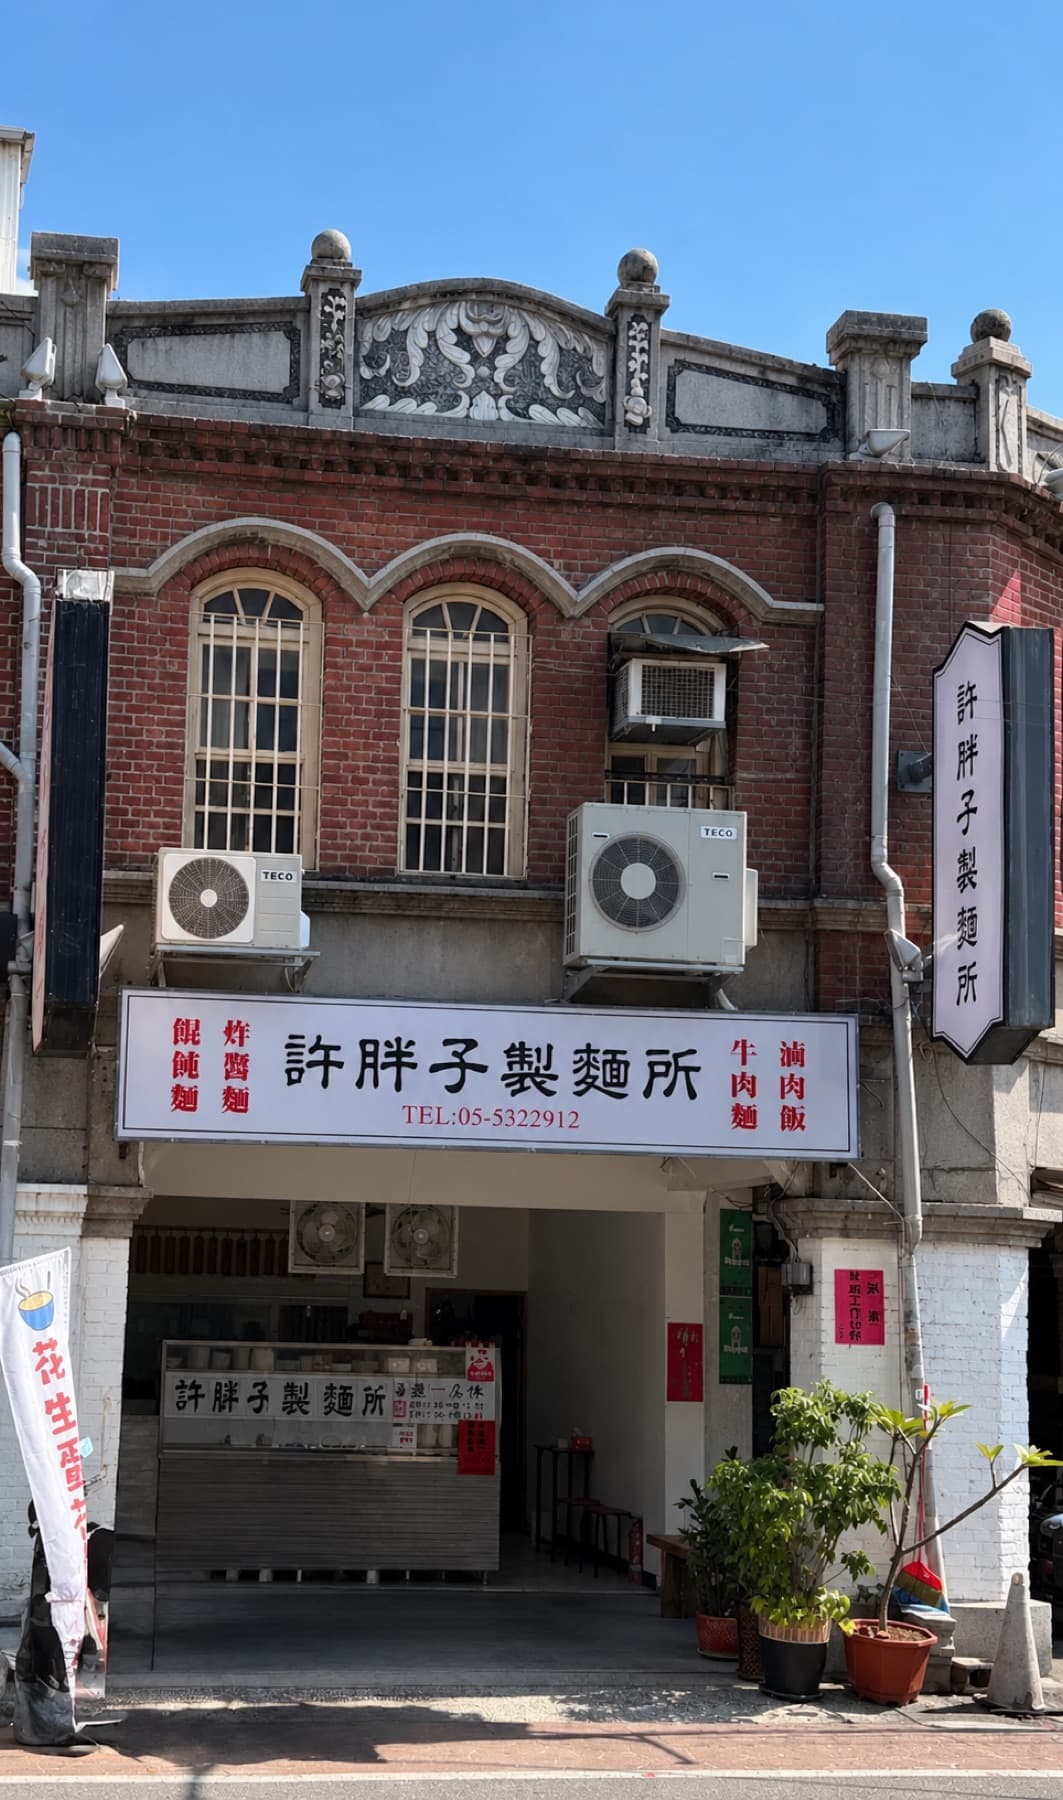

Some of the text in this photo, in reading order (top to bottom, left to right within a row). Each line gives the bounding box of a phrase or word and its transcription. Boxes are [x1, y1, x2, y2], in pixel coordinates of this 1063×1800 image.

[703, 827, 733, 838] TECO
[956, 681, 979, 1006] 許胖子製麵所
[261, 871, 294, 881] TECO
[170, 1017, 201, 1113] 餛飩麵
[222, 1019, 250, 1114] 炸醬麵
[284, 1033, 703, 1101] 許胖子製麵所
[730, 1039, 758, 1130] 牛肉麵
[779, 1040, 806, 1132] 滷肉飯
[402, 1105, 580, 1129] TEL:05-5322912
[175, 1378, 387, 1418] 許胖子製麵所
